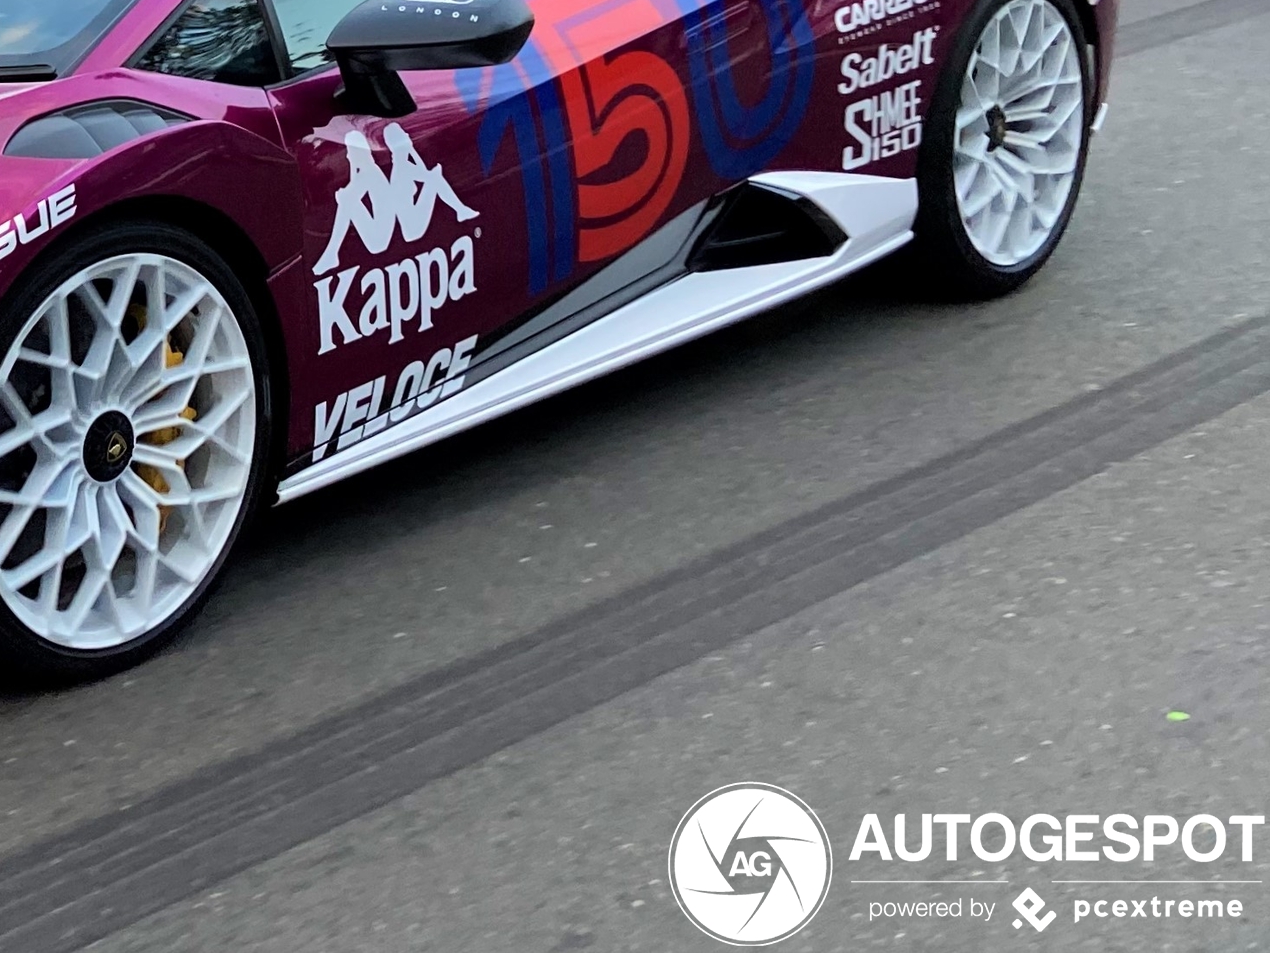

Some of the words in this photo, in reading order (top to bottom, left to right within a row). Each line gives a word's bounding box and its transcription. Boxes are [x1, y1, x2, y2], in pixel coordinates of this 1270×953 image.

[381, 5, 479, 23] LONDON
[837, 28, 938, 95] Sabelt
[313, 235, 478, 355] Kappa
[312, 334, 479, 463] VELOCE
